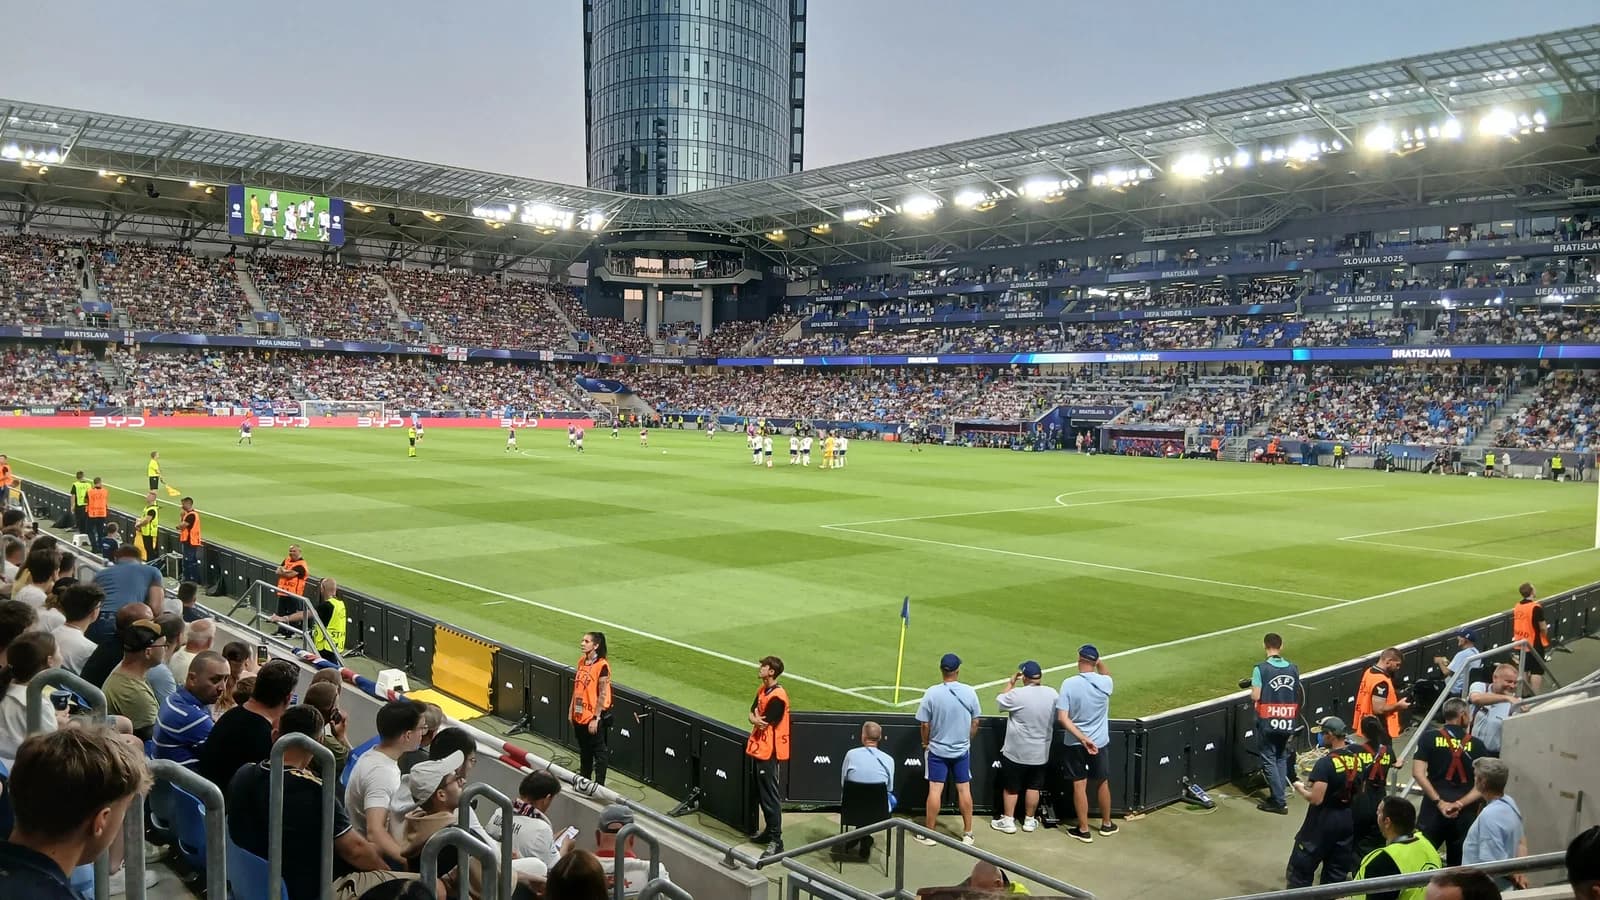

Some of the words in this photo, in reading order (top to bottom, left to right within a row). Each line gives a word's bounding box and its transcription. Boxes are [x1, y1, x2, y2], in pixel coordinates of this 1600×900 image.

[1343, 256, 1381, 266] SLOVAKIA
[1382, 255, 1404, 263] 2025
[1161, 269, 1199, 278] BRATISLAVA
[1535, 287, 1560, 296] UEFA
[1561, 286, 1594, 295] UNDER
[1333, 296, 1353, 304] UEFA
[1354, 294, 1382, 302] UNDER
[1383, 294, 1394, 302] 21
[64, 331, 110, 339] BRATISLAVA
[1139, 353, 1159, 361] 2025
[1391, 349, 1452, 358] BRATISLAVA
[88, 416, 146, 428] BYD
[1270, 718, 1294, 731] 901
